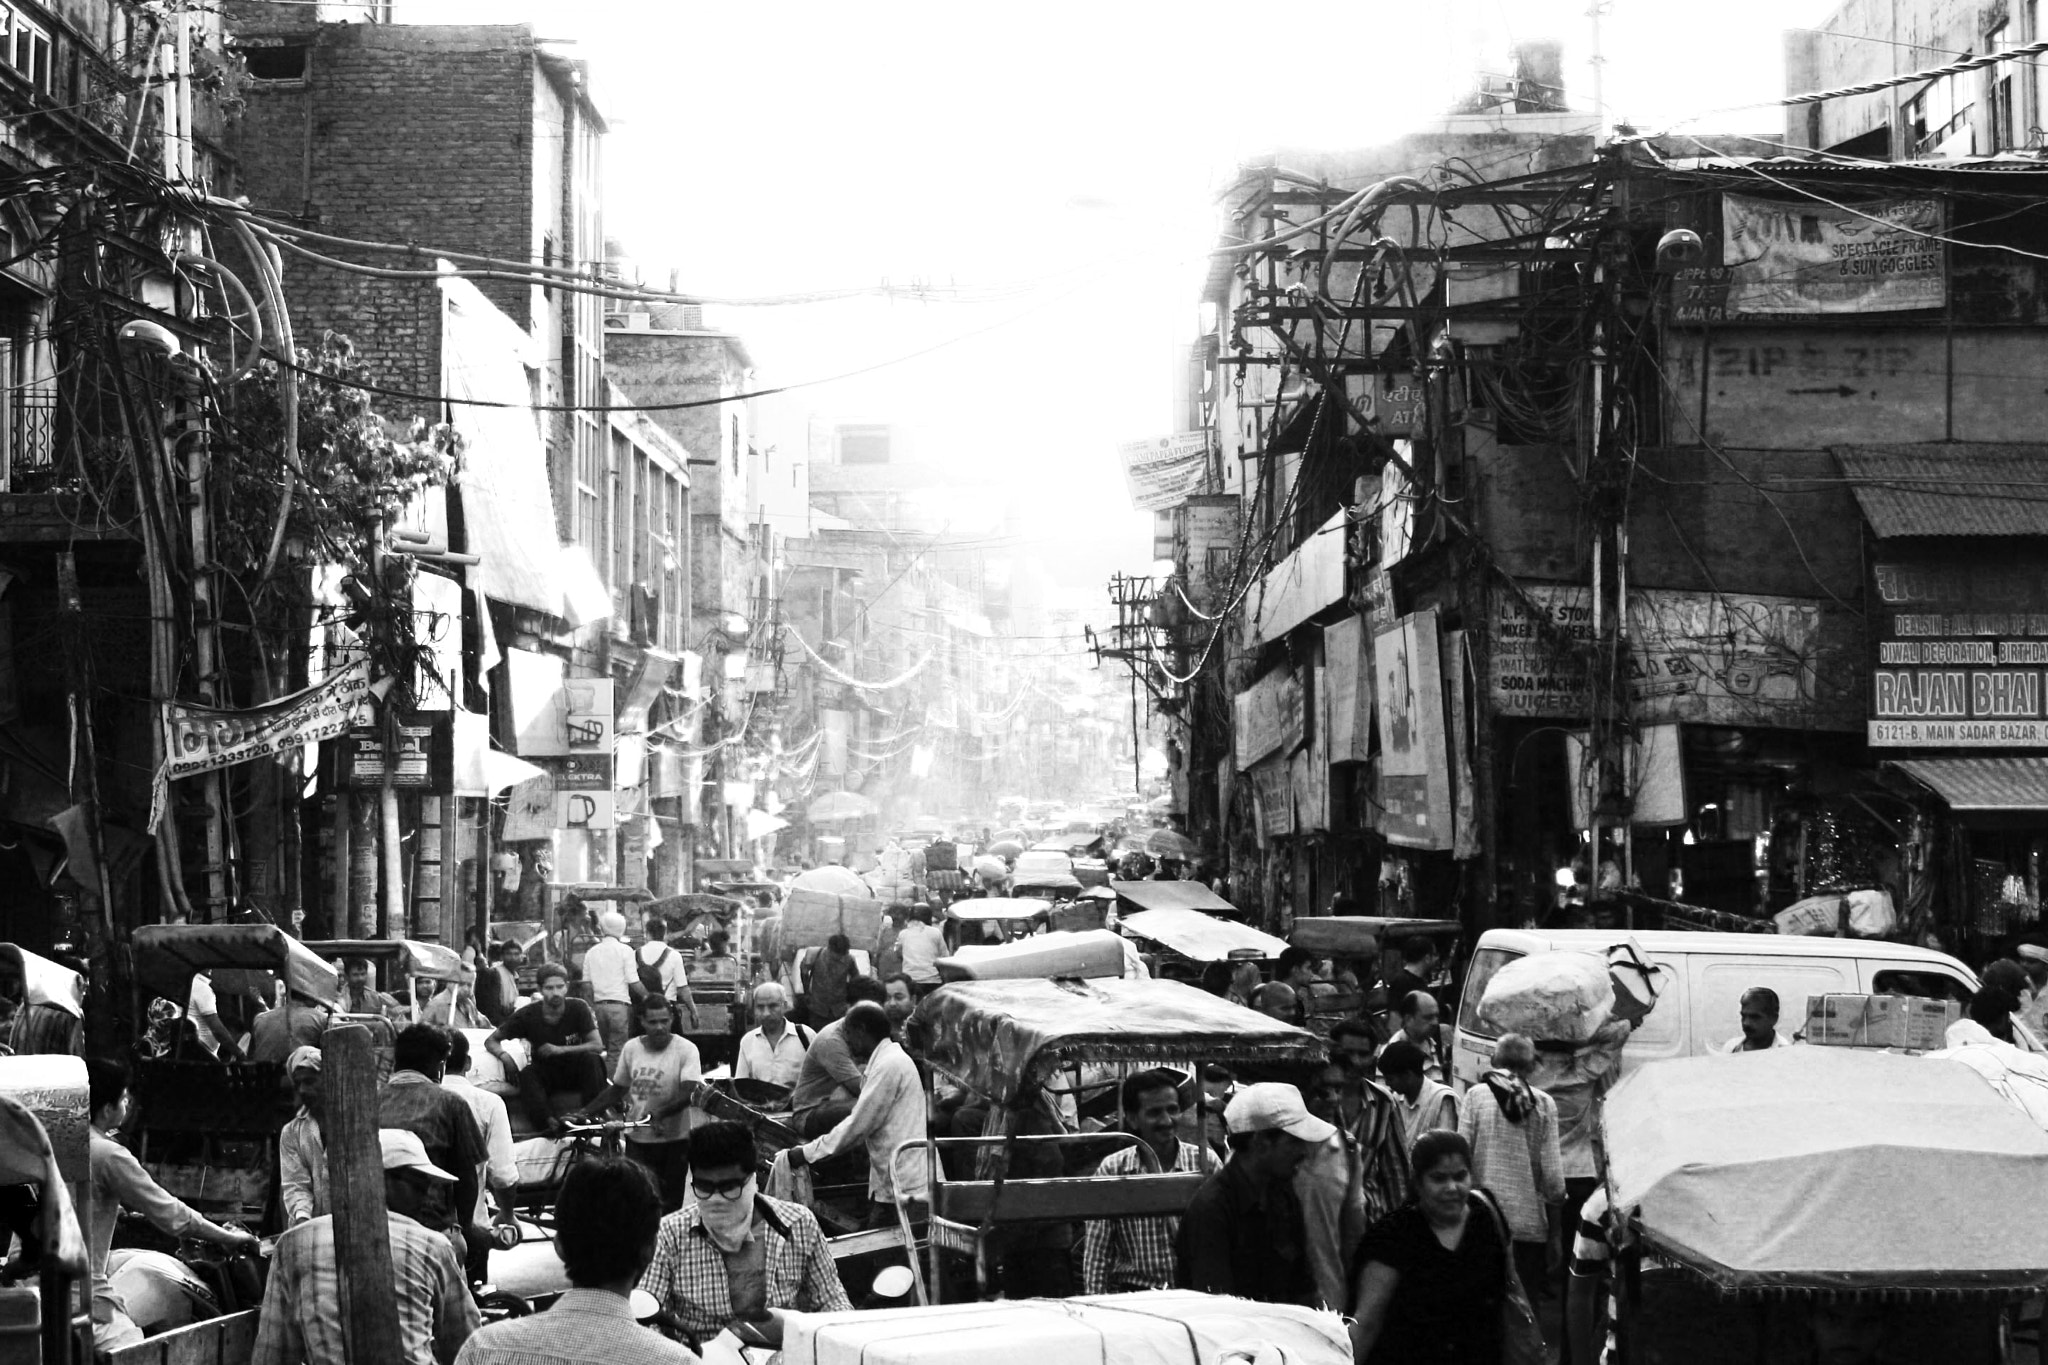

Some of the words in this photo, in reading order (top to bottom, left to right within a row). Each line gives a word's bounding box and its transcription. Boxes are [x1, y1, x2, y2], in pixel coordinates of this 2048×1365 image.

[1831, 240, 1900, 258] SPECTACLE
[1902, 237, 1943, 254] FRAME
[1839, 260, 1848, 276] &
[1852, 259, 1878, 276] SUN
[1880, 255, 1936, 275] GOGGLES
[1381, 384, 1422, 403] एटीए
[1501, 624, 1533, 638] MIXER
[1951, 613, 1973, 636] ALL
[1880, 641, 1921, 664] DIWALI
[1922, 641, 1998, 667] DECORATION,
[1998, 641, 2048, 664] BIRTHDA
[1501, 676, 1534, 691] SODA
[1876, 672, 1966, 717] RAJAN
[1972, 672, 2039, 717] BHAI
[1876, 724, 1922, 743] 6121-B,
[1926, 724, 1955, 741] MAIN
[1959, 724, 1996, 741] SADAR
[2000, 724, 2040, 743] BAZAR,
[359, 737, 422, 753] Baal
